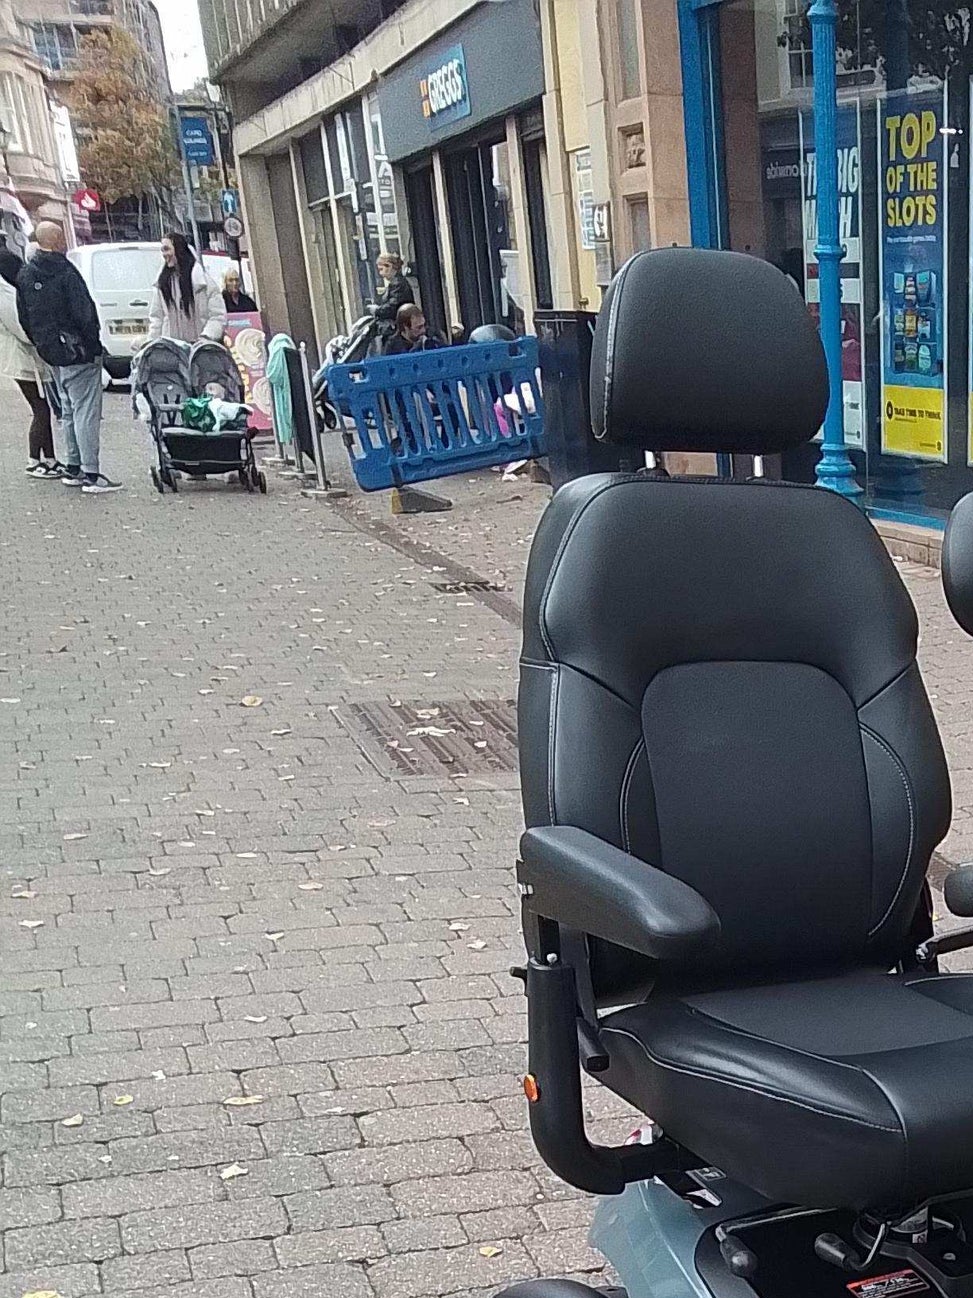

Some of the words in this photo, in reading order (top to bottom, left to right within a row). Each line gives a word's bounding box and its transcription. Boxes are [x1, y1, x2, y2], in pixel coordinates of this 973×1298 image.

[427, 58, 463, 113] GREGGS
[886, 111, 936, 161] TOP
[886, 165, 905, 194] OF
[907, 161, 937, 191] THE
[887, 194, 937, 227] SLOTS
